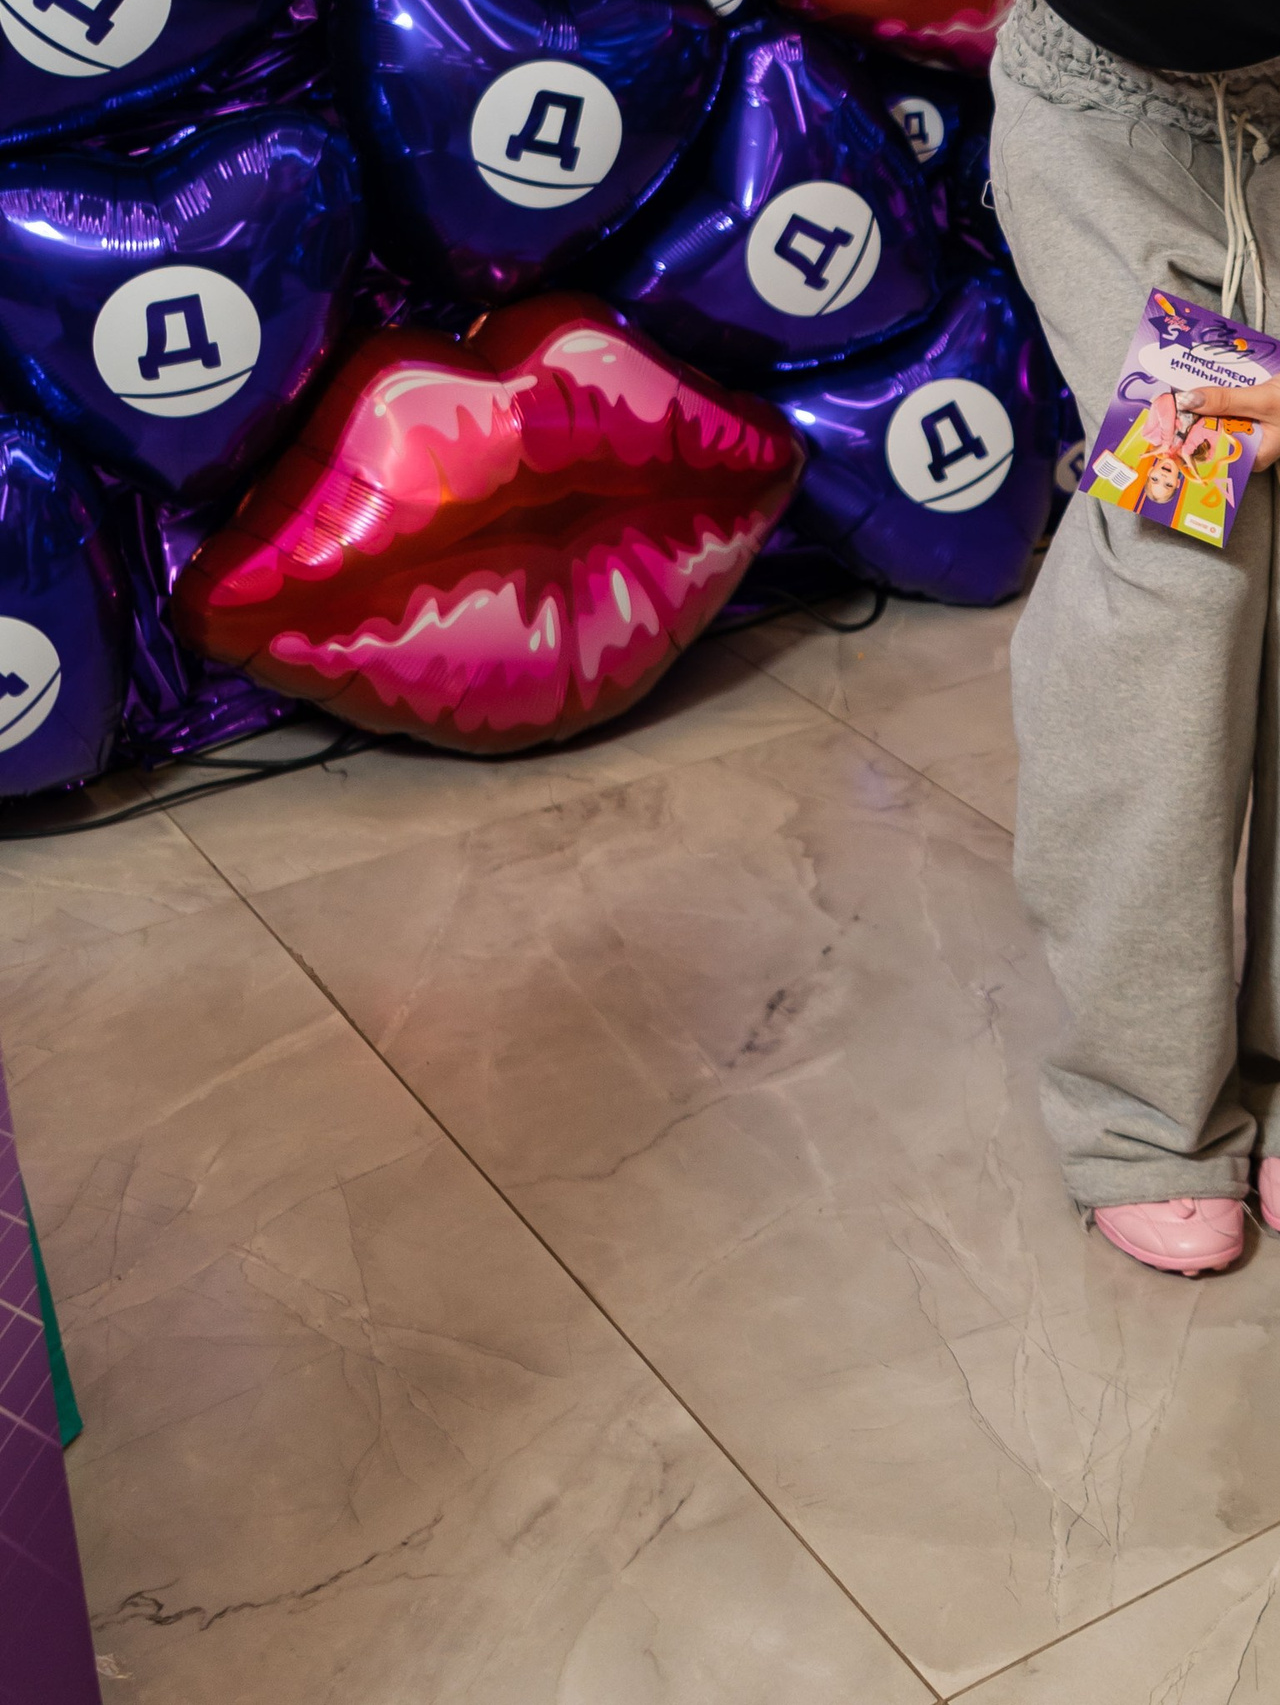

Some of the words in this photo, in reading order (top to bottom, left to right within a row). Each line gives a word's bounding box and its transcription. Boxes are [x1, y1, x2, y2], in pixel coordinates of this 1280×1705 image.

[506, 89, 584, 171] Д
[903, 112, 928, 145] Д
[773, 215, 853, 291] Д
[138, 294, 222, 380] Д
[921, 401, 986, 481] Д
